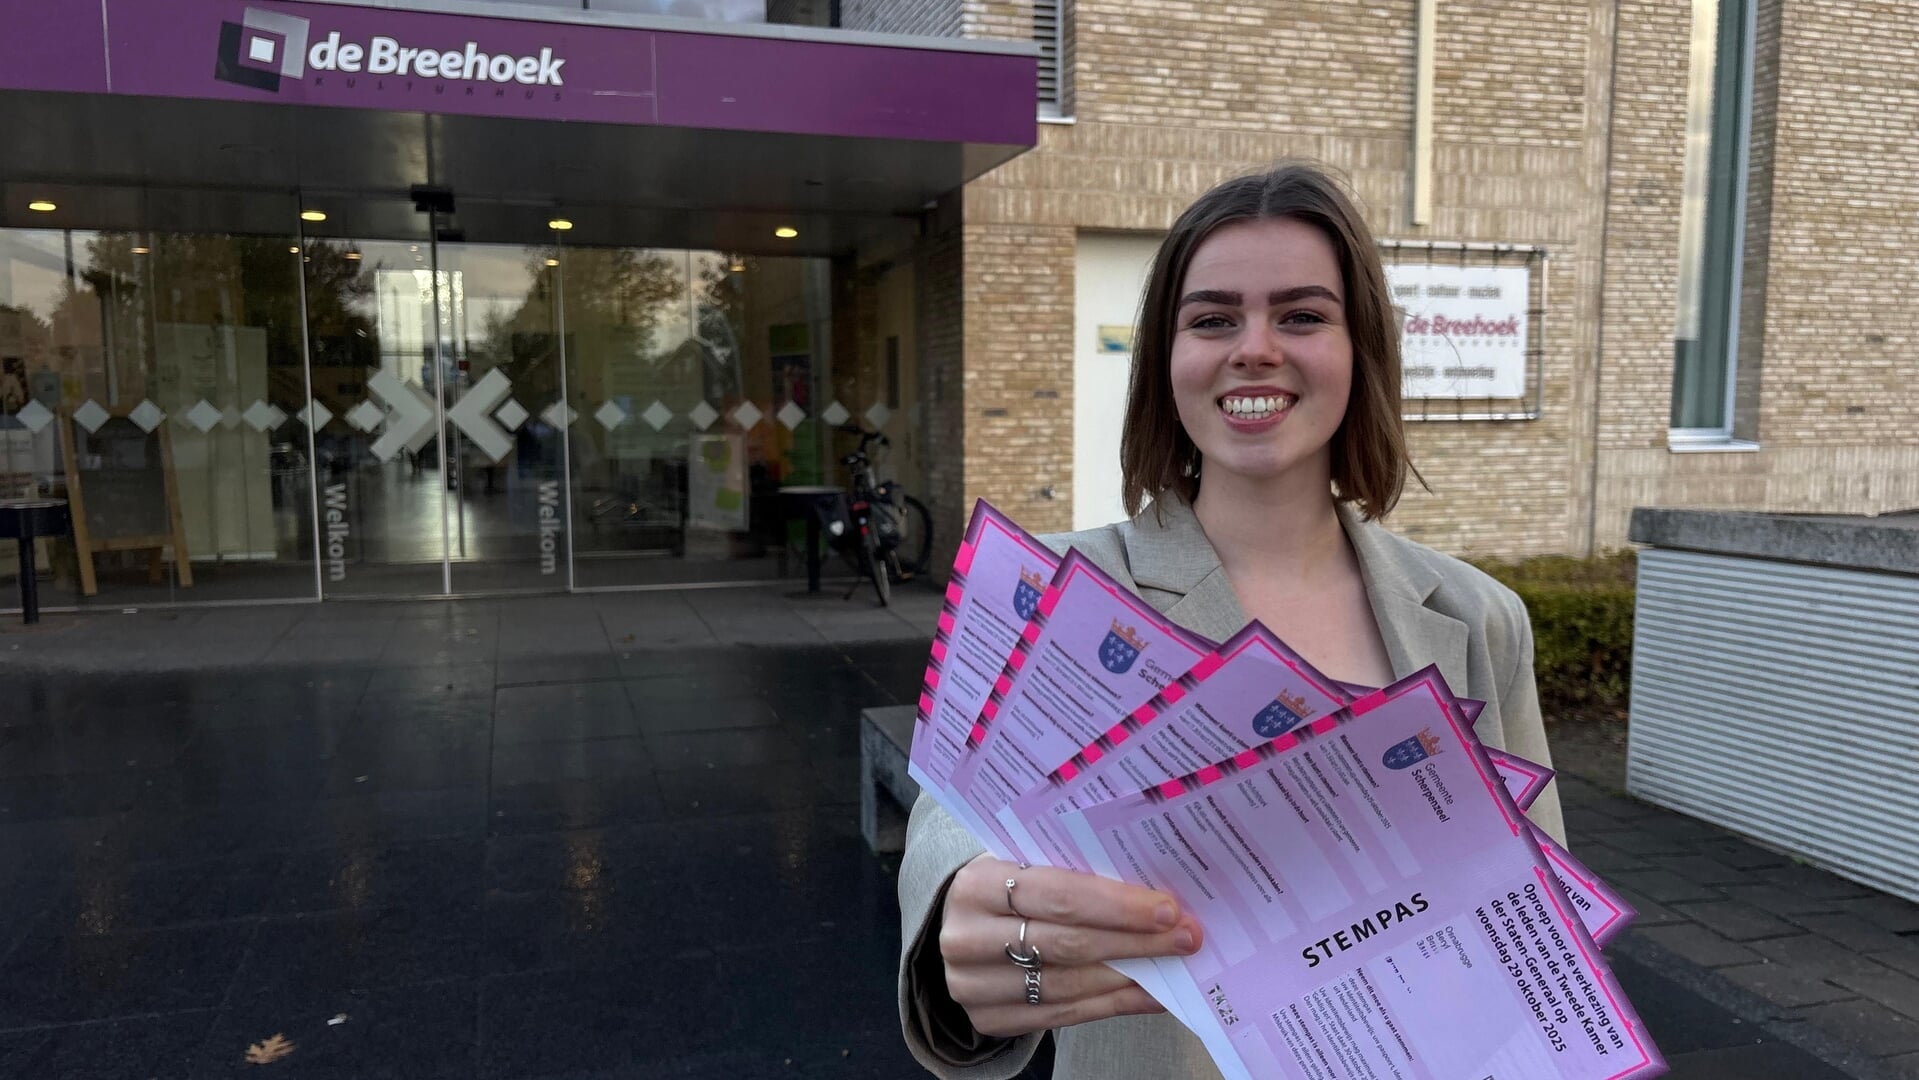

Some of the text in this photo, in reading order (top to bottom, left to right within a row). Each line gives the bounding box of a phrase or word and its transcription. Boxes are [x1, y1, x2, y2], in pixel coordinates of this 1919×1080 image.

[309, 31, 566, 86] de Breehoek
[1407, 315, 1518, 336] de Breehoek
[325, 483, 349, 581] Welkom
[538, 480, 560, 574] Welkom
[1410, 767, 1450, 824] Scherpenzeel
[1424, 761, 1455, 806] Gemeente
[1300, 890, 1430, 969] STEMPAS
[1570, 891, 1591, 911] van
[1443, 924, 1474, 970] Osnabrugge
[1472, 905, 1566, 1053] woensdag 29 oktober 2025
[1490, 897, 1568, 1026] der Staten-Generaal op
[1506, 889, 1609, 1058] de leden van de Tweede Kamer
[1520, 881, 1624, 1049] Oproep voor de verkiezing van
[1354, 966, 1370, 985] Neem
[1365, 983, 1375, 994] dit
[1370, 992, 1382, 1007] mee
[1377, 1005, 1387, 1015] als
[1385, 1018, 1398, 1033] gaat
[1288, 1003, 1301, 1019] Deze
[1296, 1017, 1316, 1043] stempas
[1314, 1047, 1329, 1066] alleen
[1324, 1064, 1337, 1080] voor
